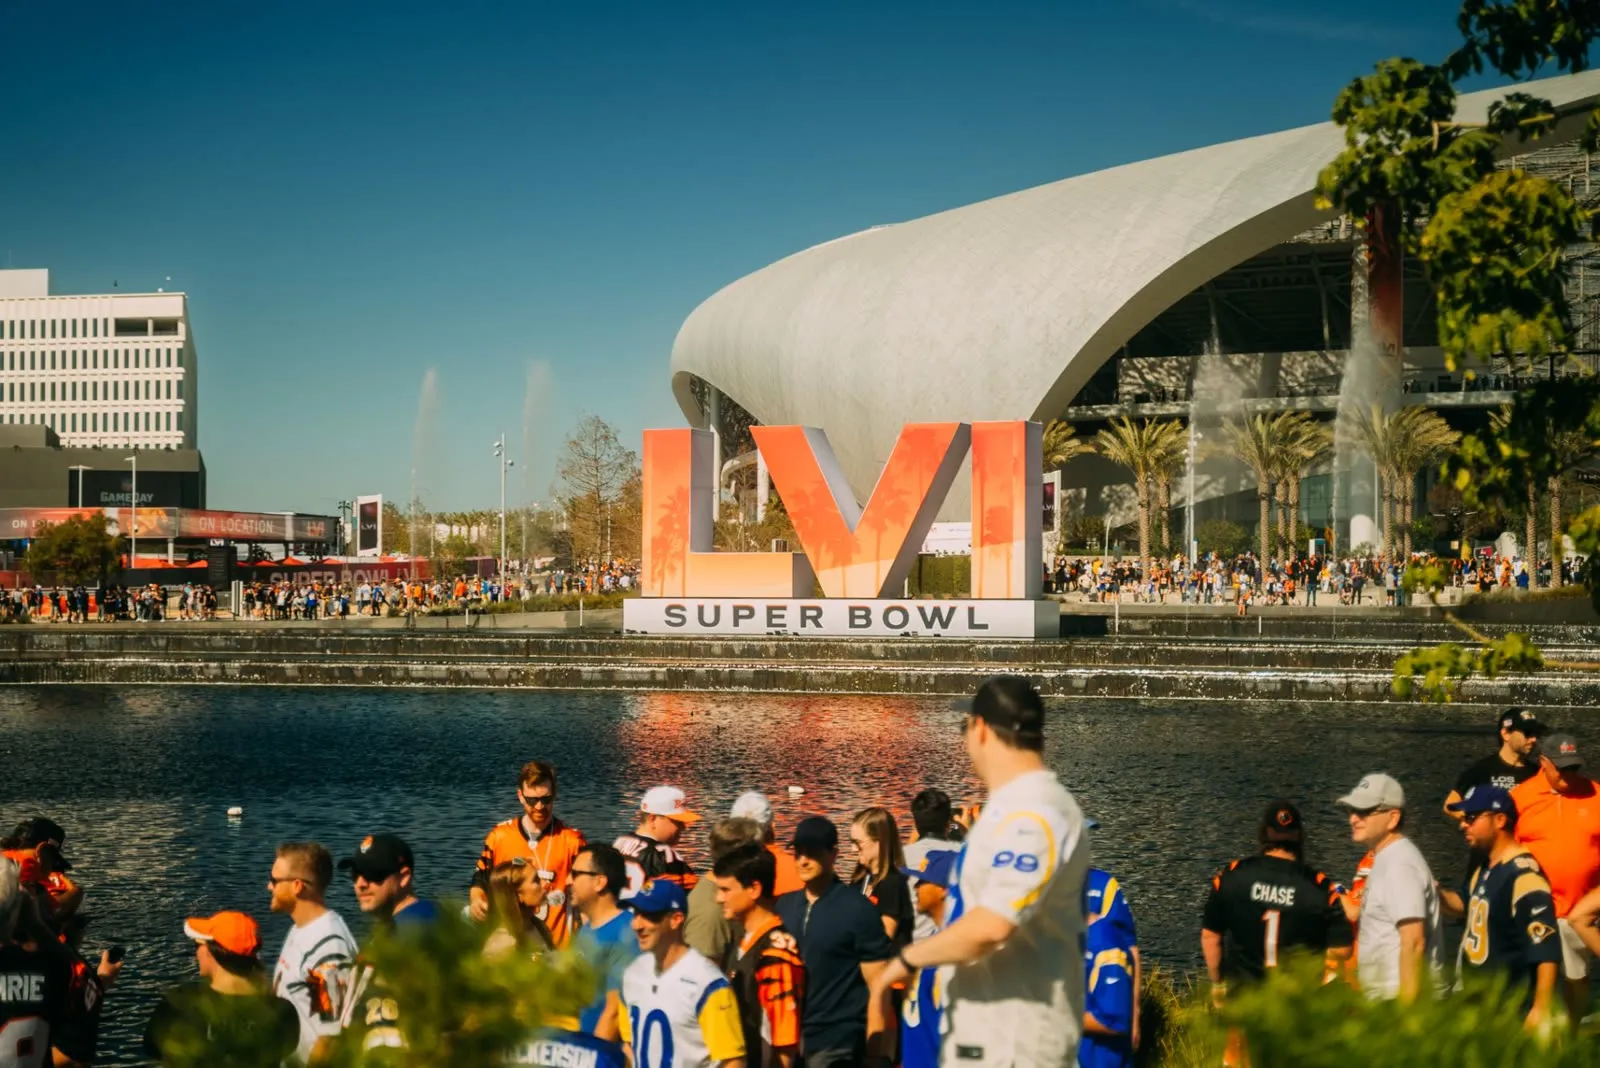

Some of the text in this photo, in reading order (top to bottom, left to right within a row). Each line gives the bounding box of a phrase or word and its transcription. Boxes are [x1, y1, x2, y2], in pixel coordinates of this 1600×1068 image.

[642, 420, 1043, 598] LVI
[12, 520, 27, 528] ON
[200, 517, 274, 533] ON LOCATION
[664, 604, 990, 631] SUPER BOWL
[1250, 881, 1296, 907] CHASE
[1261, 908, 1281, 968] 1
